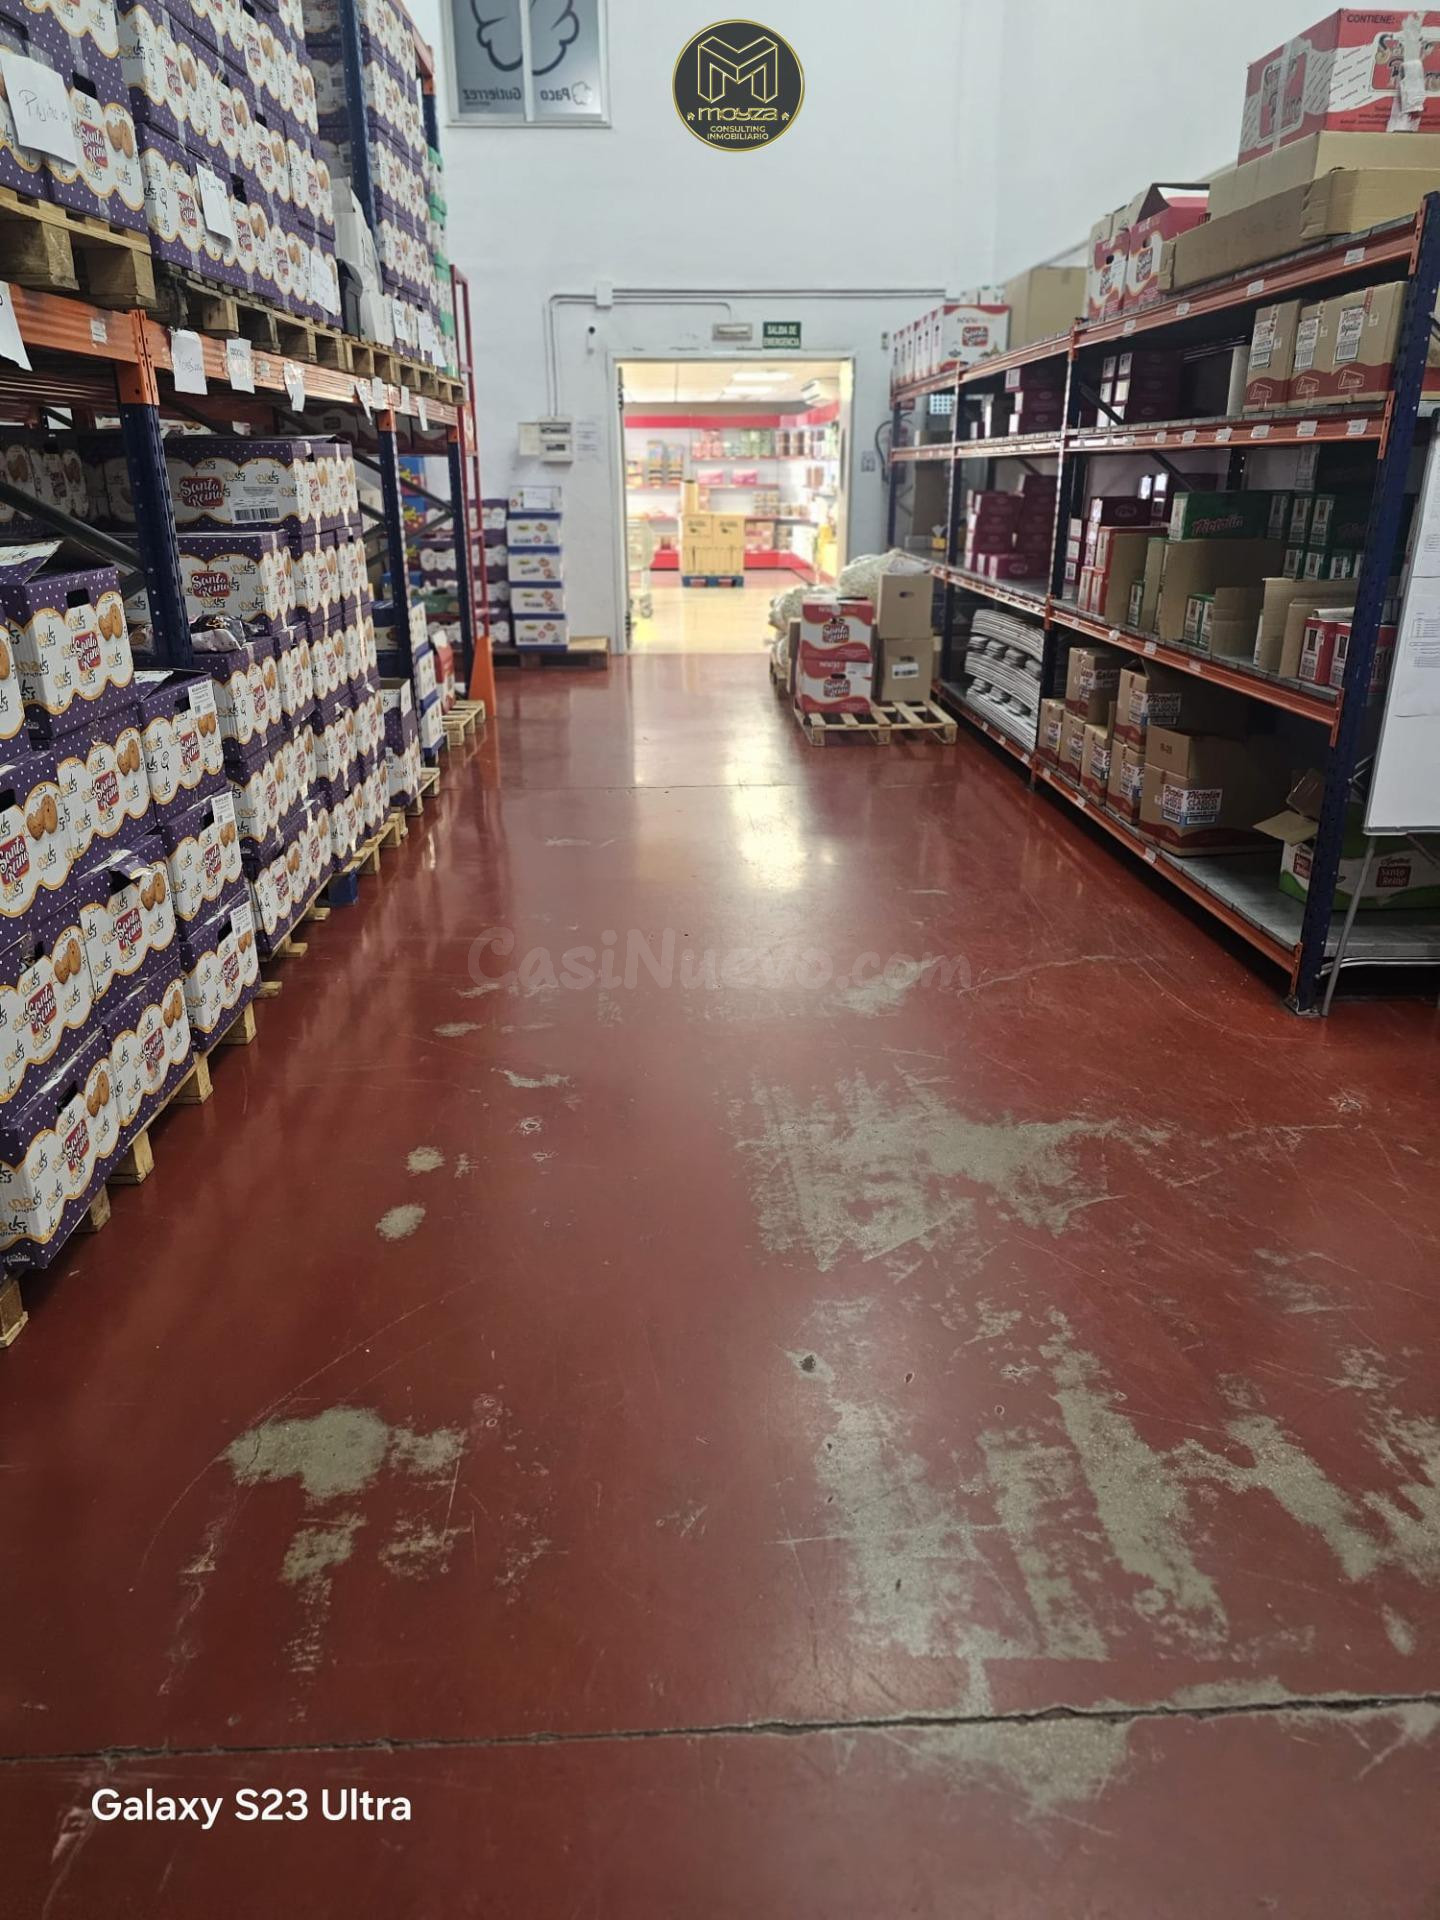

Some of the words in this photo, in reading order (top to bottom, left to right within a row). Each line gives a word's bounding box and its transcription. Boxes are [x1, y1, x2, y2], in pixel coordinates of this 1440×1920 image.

[1347, 14, 1396, 25] CONTIENE:
[180, 478, 219, 498] Santo
[192, 572, 227, 589] Santo
[201, 583, 229, 598] Reino
[1187, 790, 1221, 800] Pictolin
[0, 838, 25, 872] Santo
